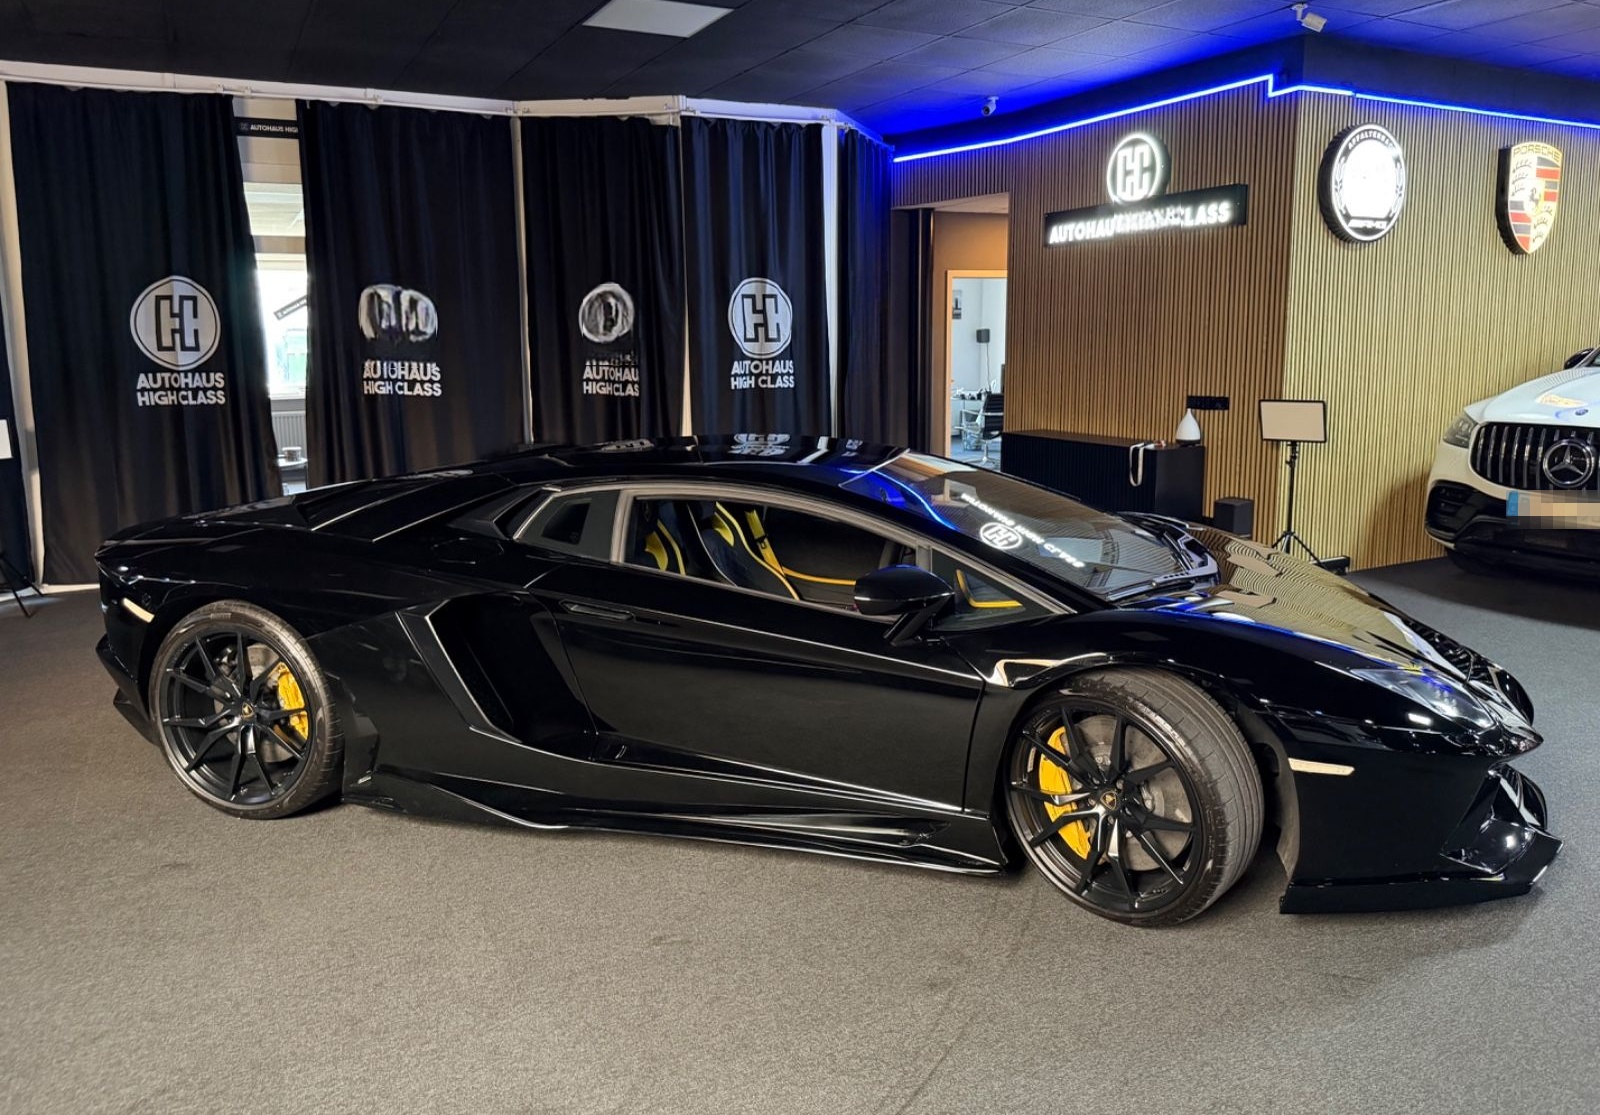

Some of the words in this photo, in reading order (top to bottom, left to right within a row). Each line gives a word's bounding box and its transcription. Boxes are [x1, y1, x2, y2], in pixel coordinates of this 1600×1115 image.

[250, 124, 284, 133] AUTOHAUS
[1513, 144, 1561, 163] PORSCHE
[1049, 216, 1121, 245] AUTOHAU
[583, 365, 640, 382] AUTOHAU
[731, 360, 794, 375] AUTOHAUS
[136, 372, 225, 390] AUTOHAUS
[363, 381, 393, 395] HIGH
[395, 381, 442, 397] CLASS
[583, 381, 613, 395] HIGH
[613, 383, 640, 397] CLAS
[731, 376, 755, 389] HIGH
[757, 375, 795, 389] CLASS
[137, 390, 178, 407] HIGH
[178, 390, 226, 406] CLASS
